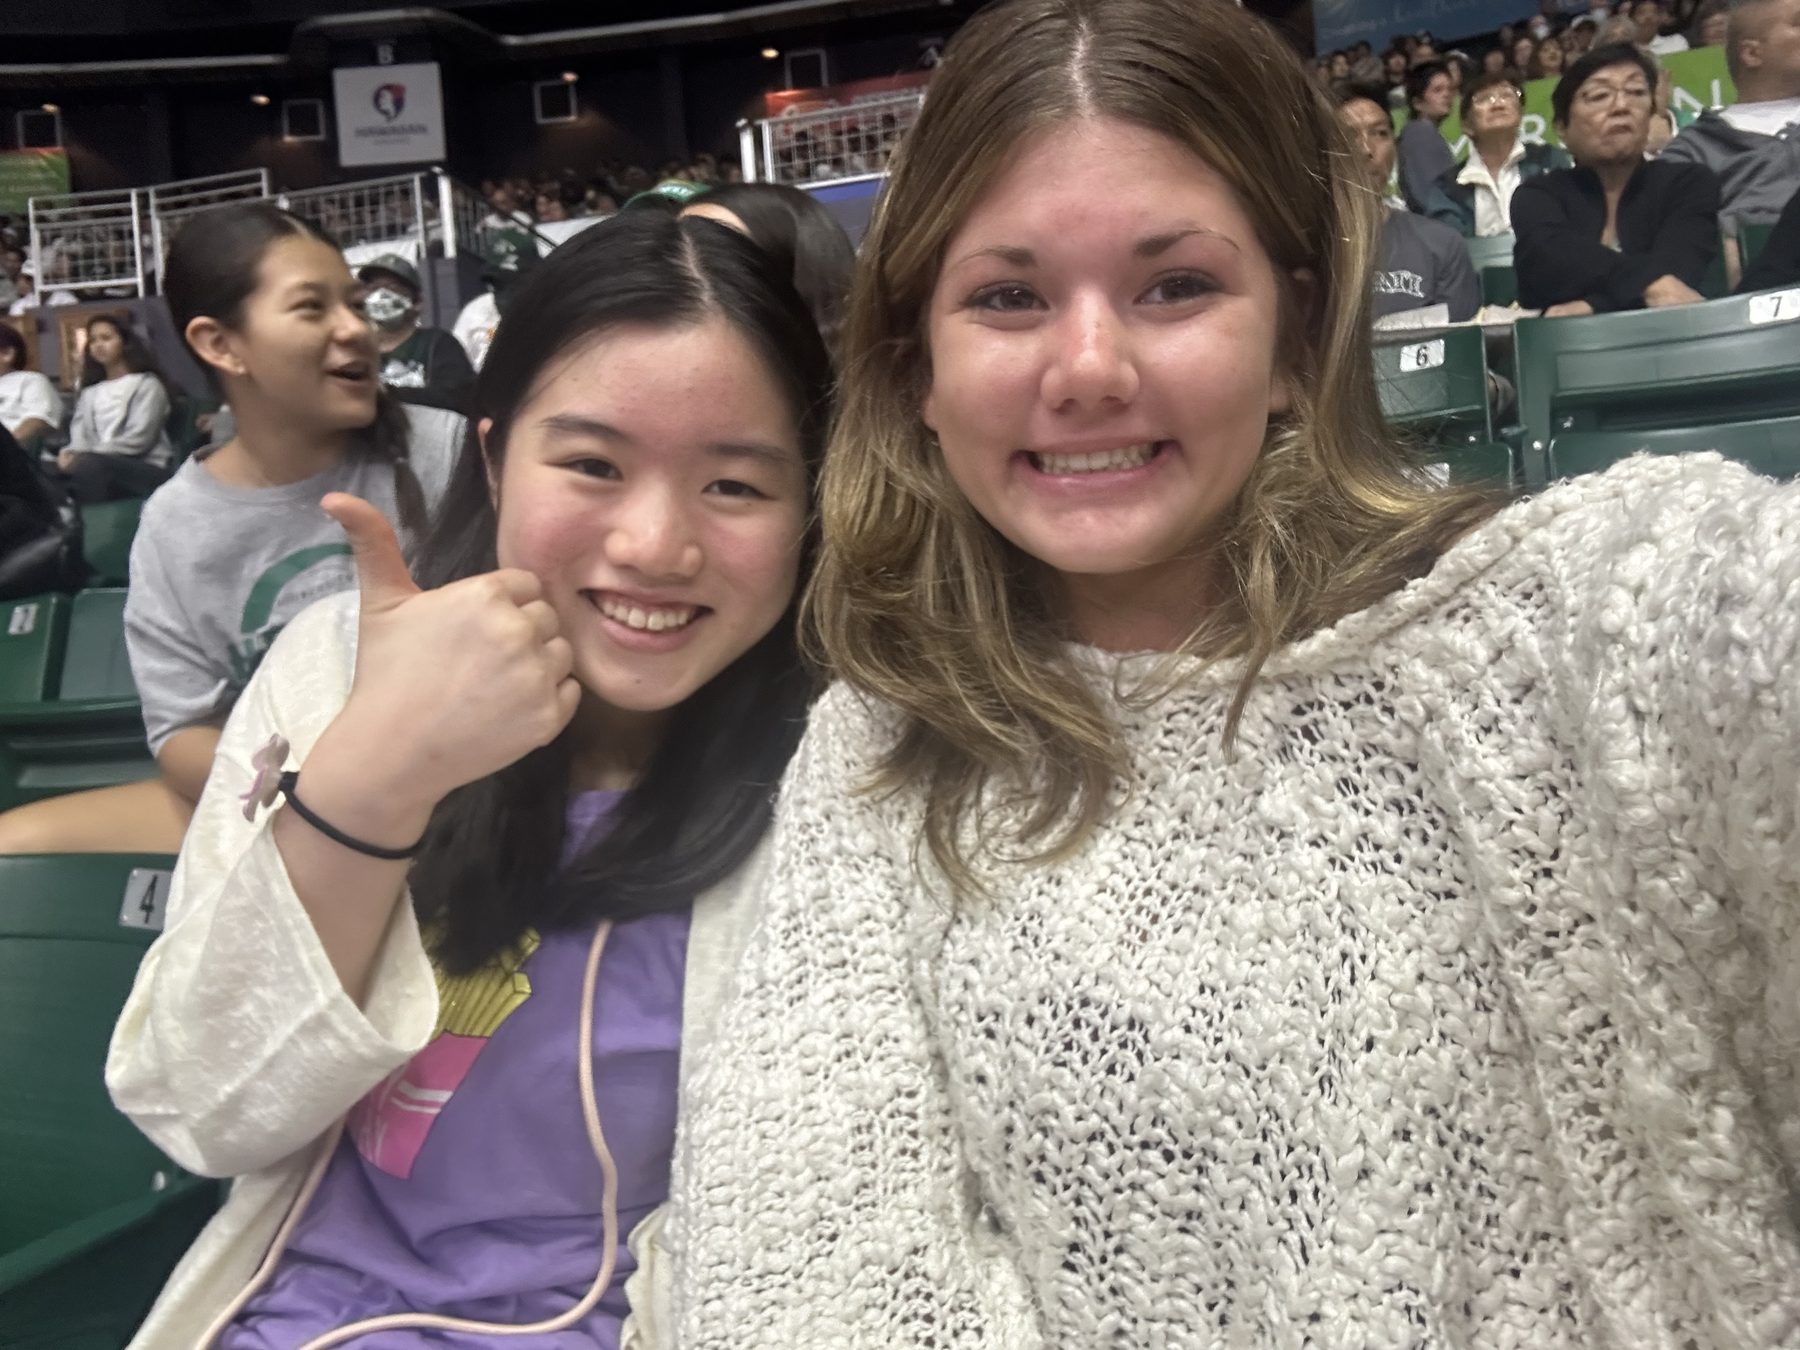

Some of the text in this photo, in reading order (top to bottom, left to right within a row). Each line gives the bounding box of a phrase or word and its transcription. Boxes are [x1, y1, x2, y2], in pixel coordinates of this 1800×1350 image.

[1769, 296, 1783, 317] 7
[1415, 344, 1428, 367] 6
[139, 874, 158, 924] 4
